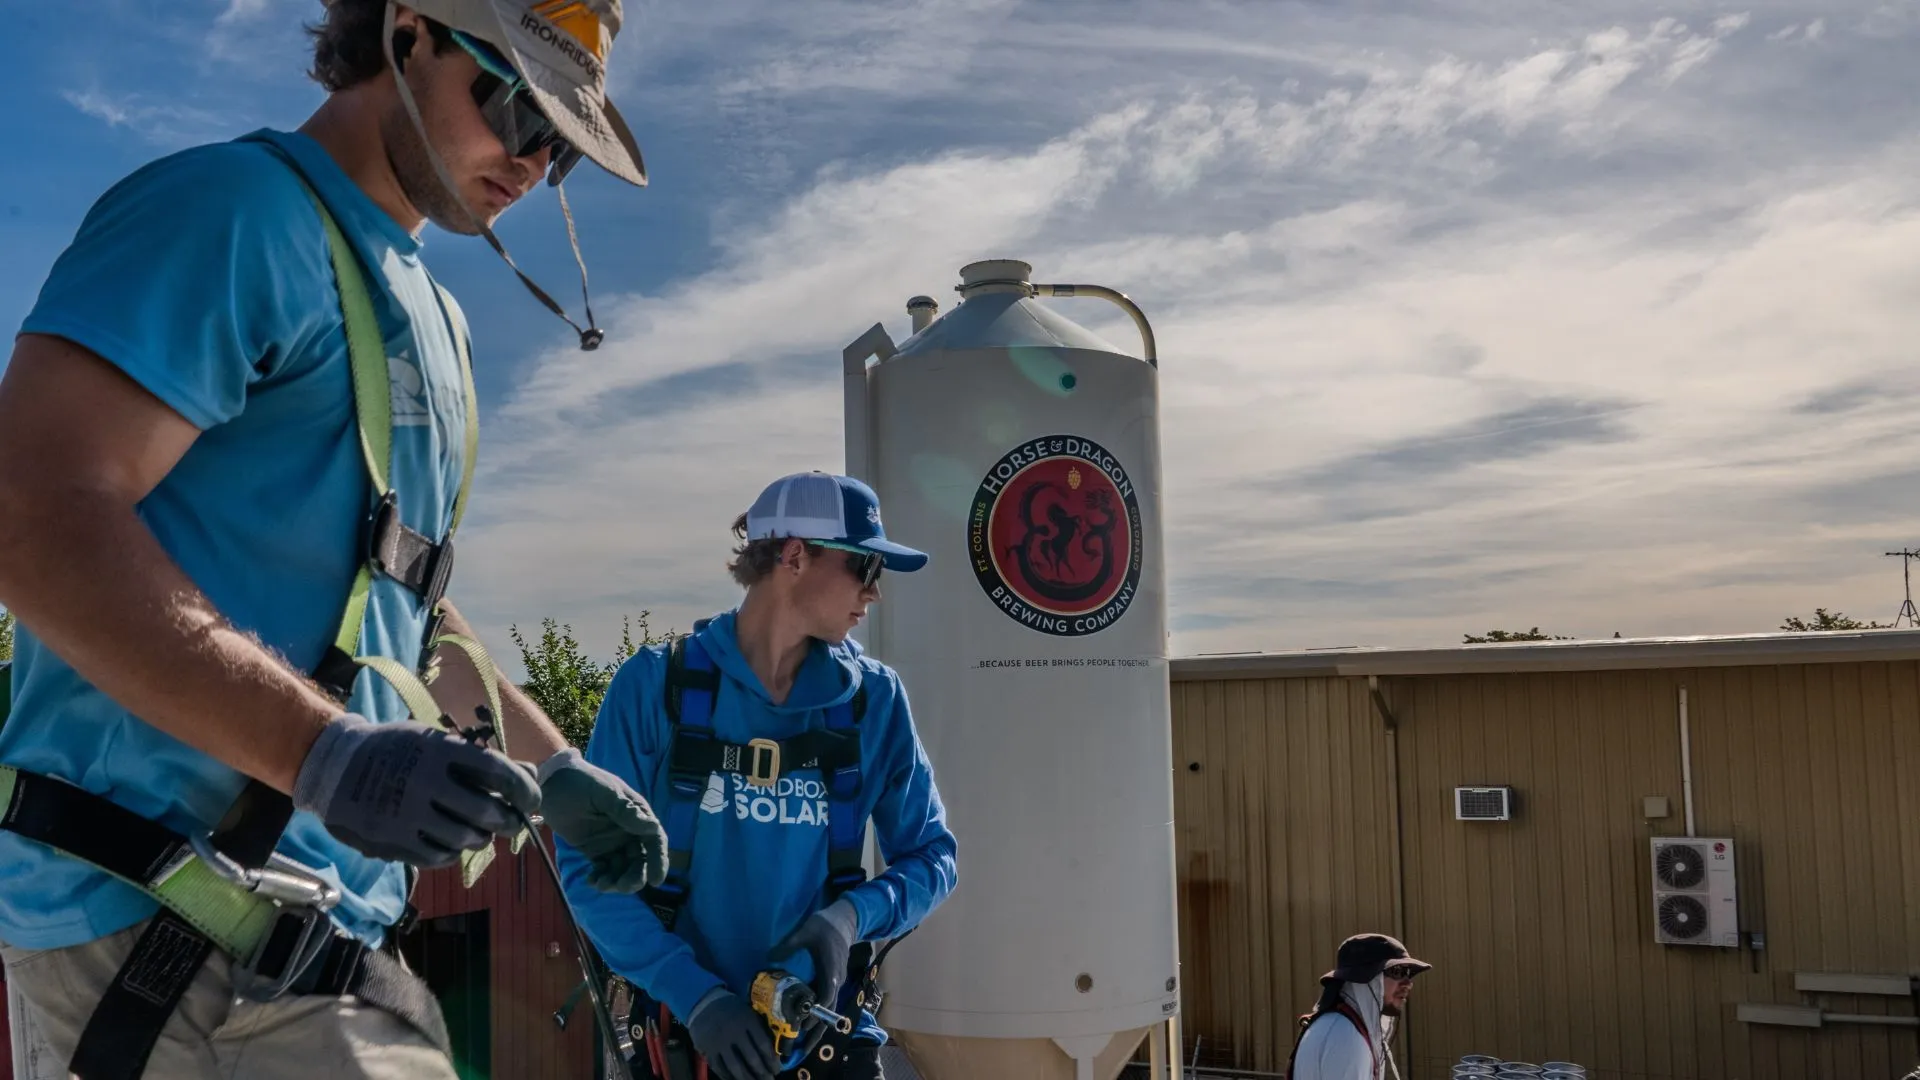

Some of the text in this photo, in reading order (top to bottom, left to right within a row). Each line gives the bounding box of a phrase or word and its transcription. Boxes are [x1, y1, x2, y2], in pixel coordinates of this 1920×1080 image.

[982, 438, 1132, 499] HORSE & DRAGON
[973, 502, 989, 573] FT. COLLINS
[991, 580, 1134, 633] BREWING COMPANY
[1025, 659, 1049, 668] BEER
[1051, 658, 1085, 668] BRINGS
[1087, 658, 1116, 667] PEOPLE
[735, 792, 829, 826] SOLAR
